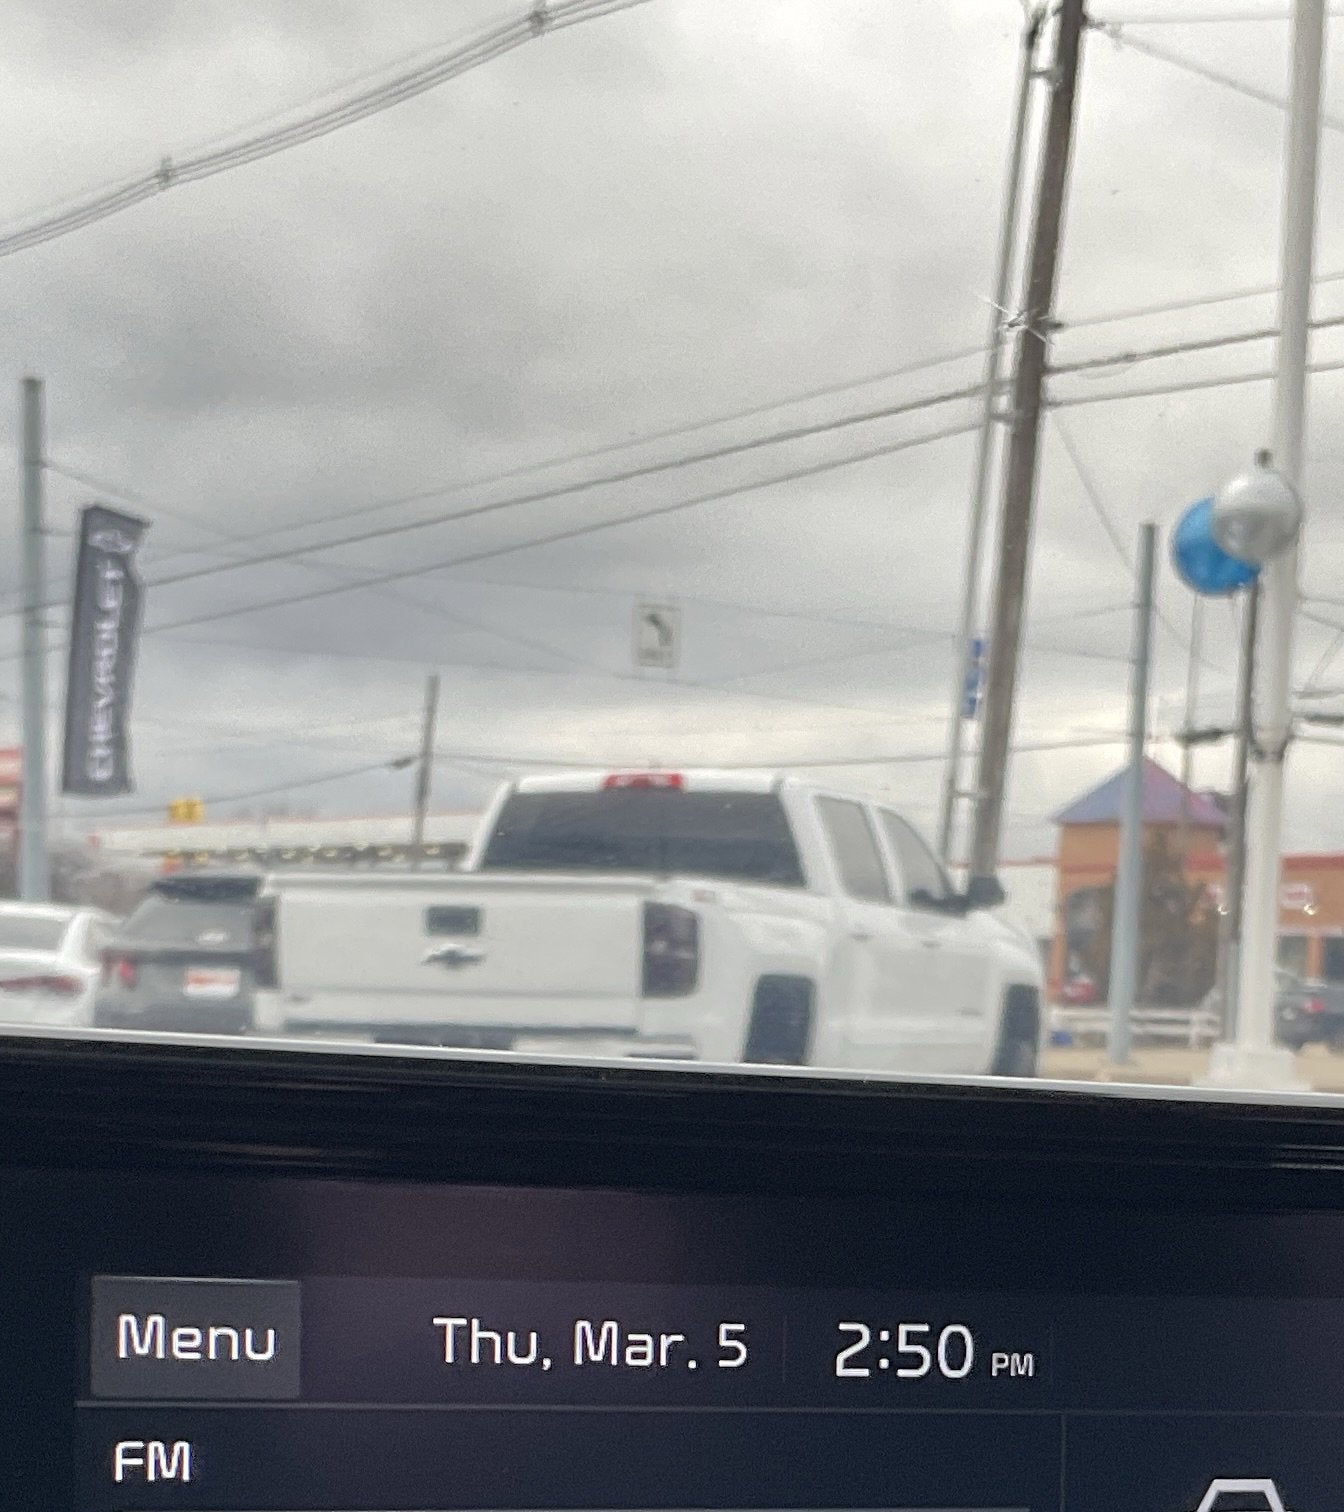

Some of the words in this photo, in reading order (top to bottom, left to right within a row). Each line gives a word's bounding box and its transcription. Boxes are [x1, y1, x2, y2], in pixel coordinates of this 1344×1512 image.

[118, 1314, 275, 1361] Menu
[432, 1317, 551, 1371] Thu,
[574, 1319, 697, 1369] Mar.
[718, 1322, 748, 1368] 5
[835, 1322, 974, 1379] 2:50
[991, 1352, 1034, 1377] PM
[114, 1440, 190, 1483] FM
